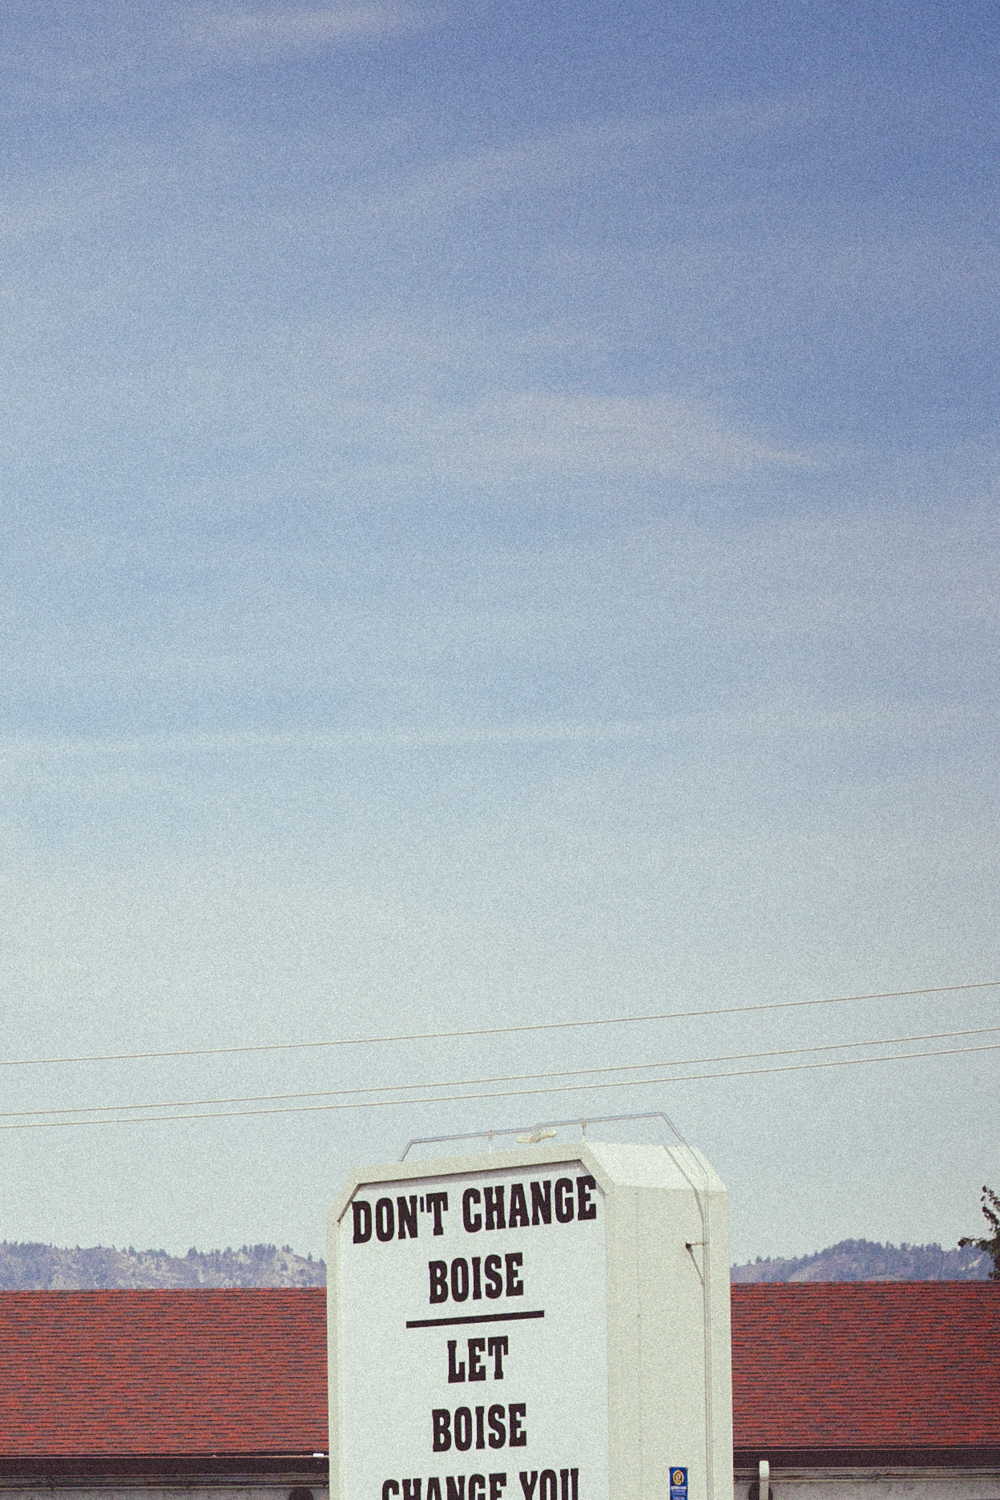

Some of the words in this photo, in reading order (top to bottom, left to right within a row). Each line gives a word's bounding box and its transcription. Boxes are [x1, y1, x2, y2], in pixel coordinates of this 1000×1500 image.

[352, 1191, 449, 1244] DON'T
[462, 1174, 597, 1233] CHANGE
[428, 1252, 524, 1305] BOISE
[447, 1335, 509, 1384] LET
[431, 1402, 527, 1453] BOISE
